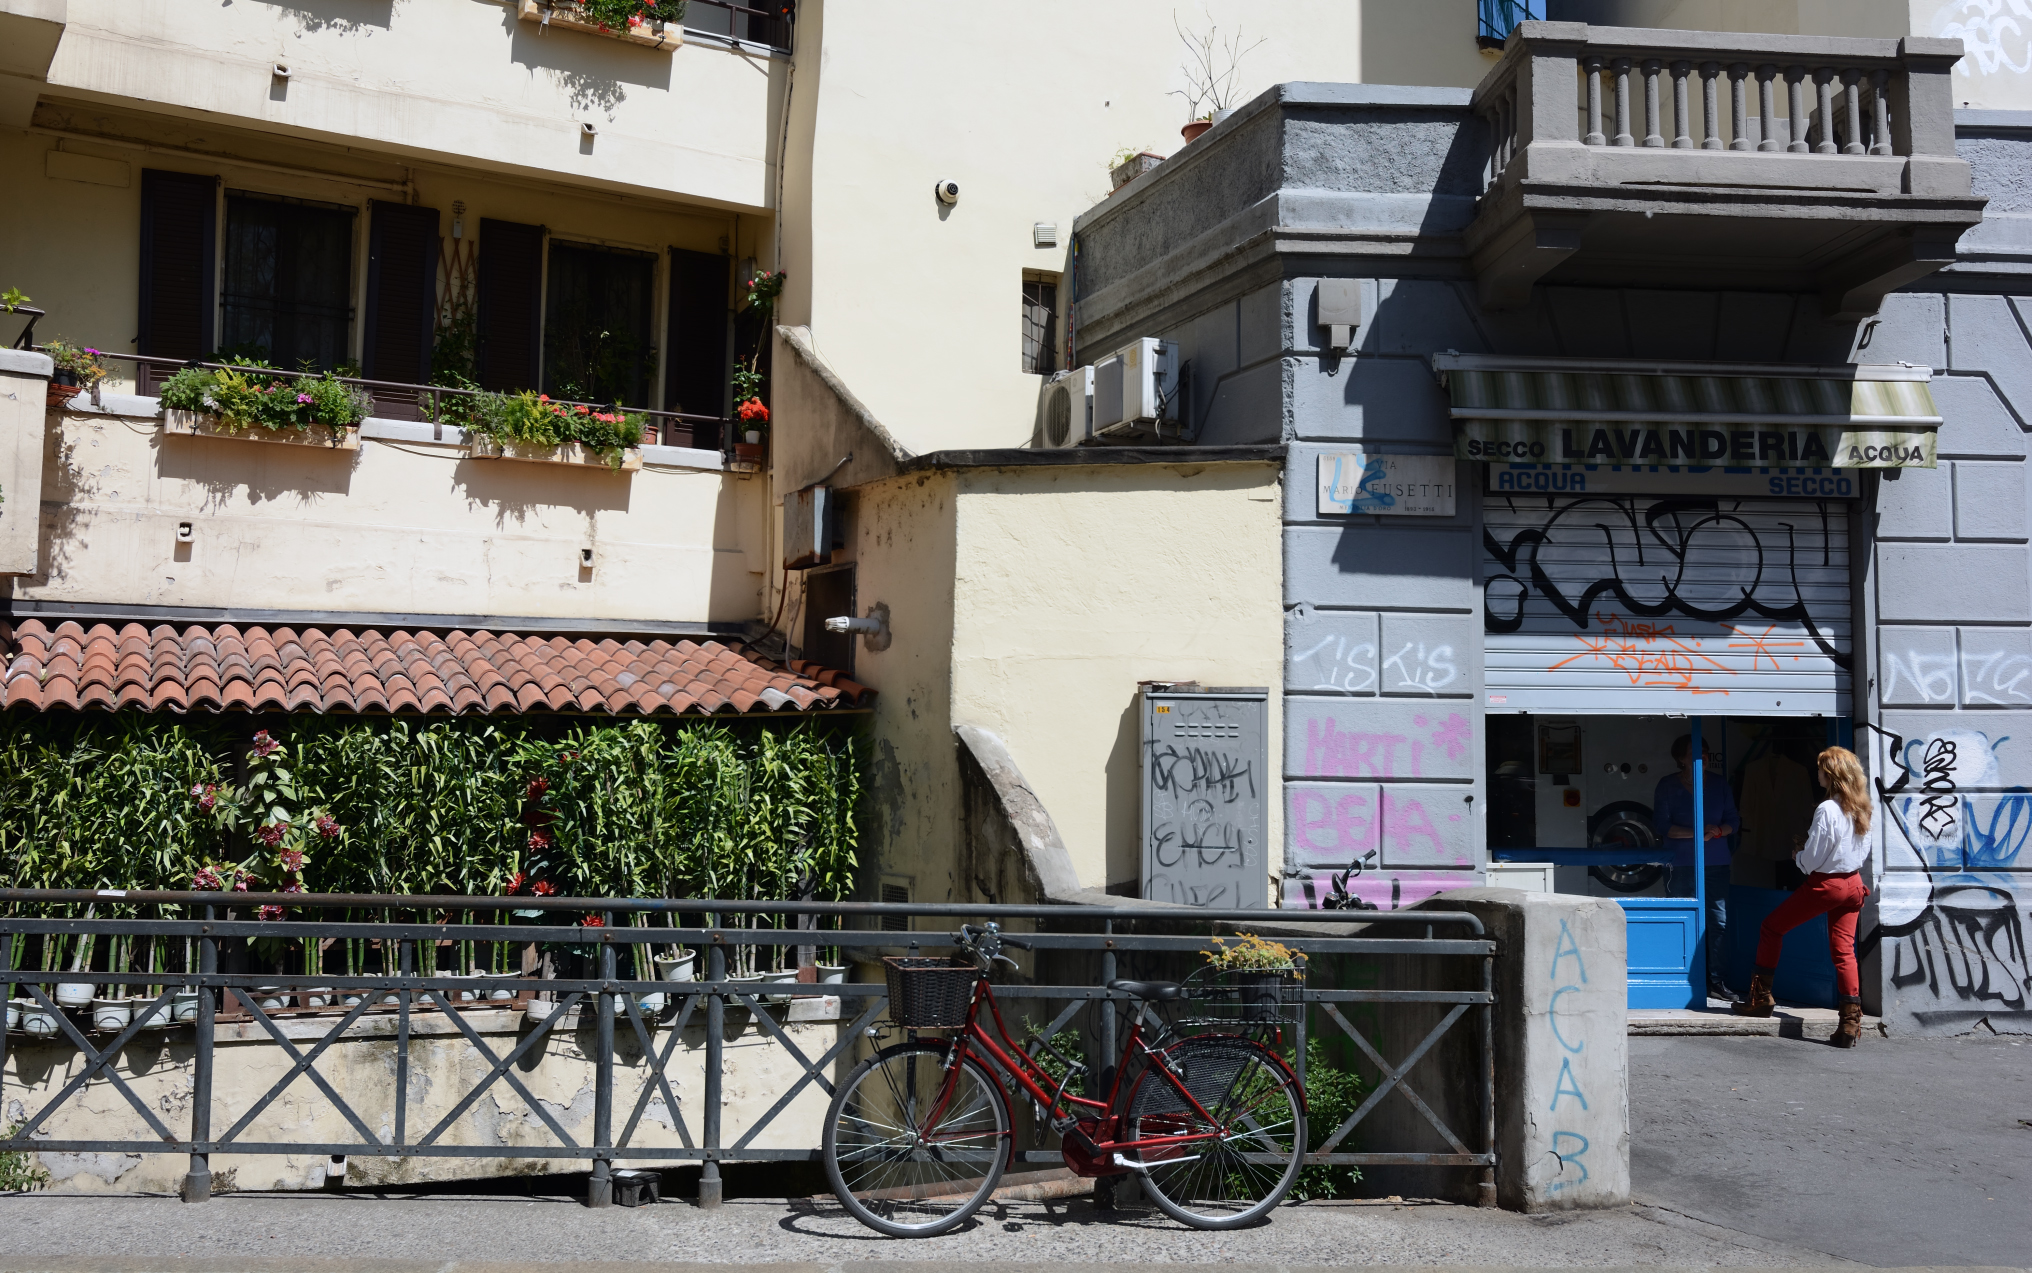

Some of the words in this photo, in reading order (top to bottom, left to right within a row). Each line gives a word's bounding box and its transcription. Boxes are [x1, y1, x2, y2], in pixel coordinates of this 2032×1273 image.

[1467, 440, 1545, 458] SECCO
[1562, 429, 1830, 461] LAVANDERIA
[1848, 445, 1924, 462] ACQUA
[1376, 460, 1397, 470] VIA
[1323, 485, 1363, 495] MARIO
[1371, 483, 1453, 498] FUSETTI
[1499, 472, 1586, 492] ACQUA
[1769, 477, 1852, 496] SECCO
[1548, 918, 1589, 1192] ACAB
